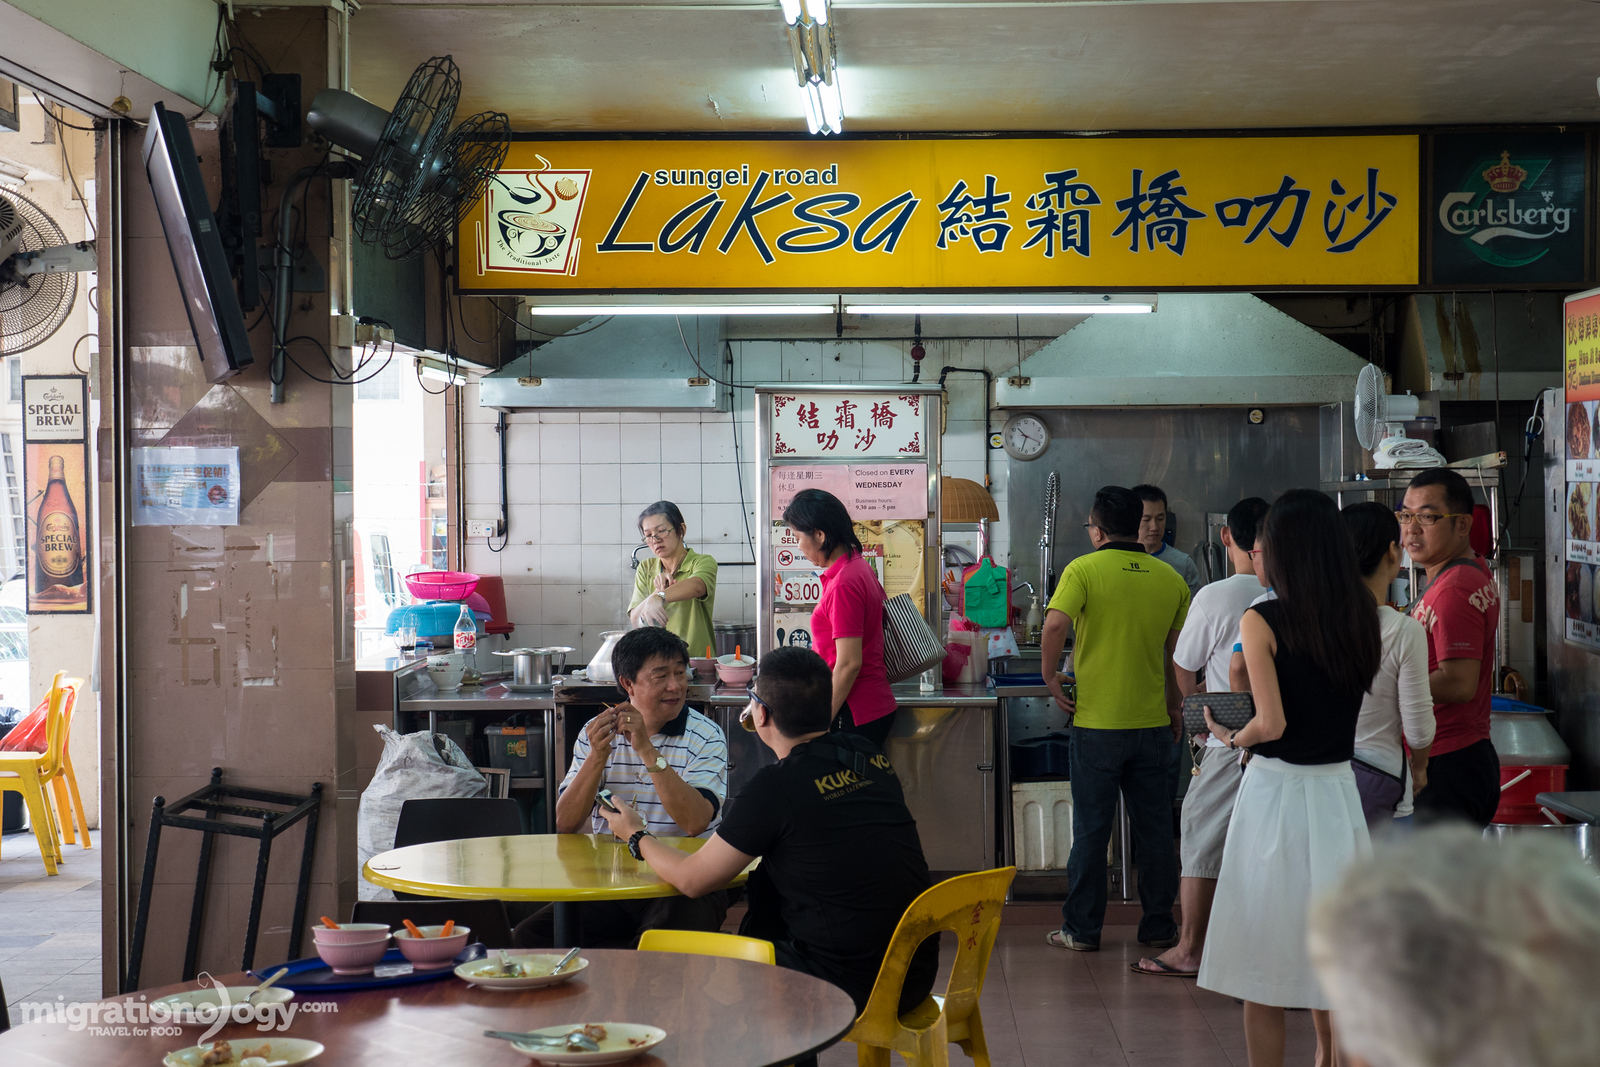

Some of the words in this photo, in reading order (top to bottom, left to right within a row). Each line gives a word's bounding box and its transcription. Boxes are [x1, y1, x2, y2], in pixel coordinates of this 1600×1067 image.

[654, 163, 750, 189] sungei
[773, 163, 838, 185] road
[936, 167, 1398, 258] 結霜橋叻沙
[1439, 191, 1571, 236] Carlsberg
[497, 239, 506, 251] The
[506, 251, 543, 266] Traditional
[544, 252, 560, 264] Taste
[28, 404, 82, 415] SPECIAL
[797, 400, 898, 430] 結霜橋
[36, 415, 74, 426] BREW
[816, 428, 877, 452] 叻沙
[778, 470, 823, 480] 每逢星期三
[889, 468, 915, 476] EVERY
[778, 482, 796, 492] 休息
[855, 481, 903, 489] WEDNESDAY
[40, 533, 77, 544] SPECIAL
[45, 542, 74, 552] BREW
[823, 789, 846, 801] WORLD
